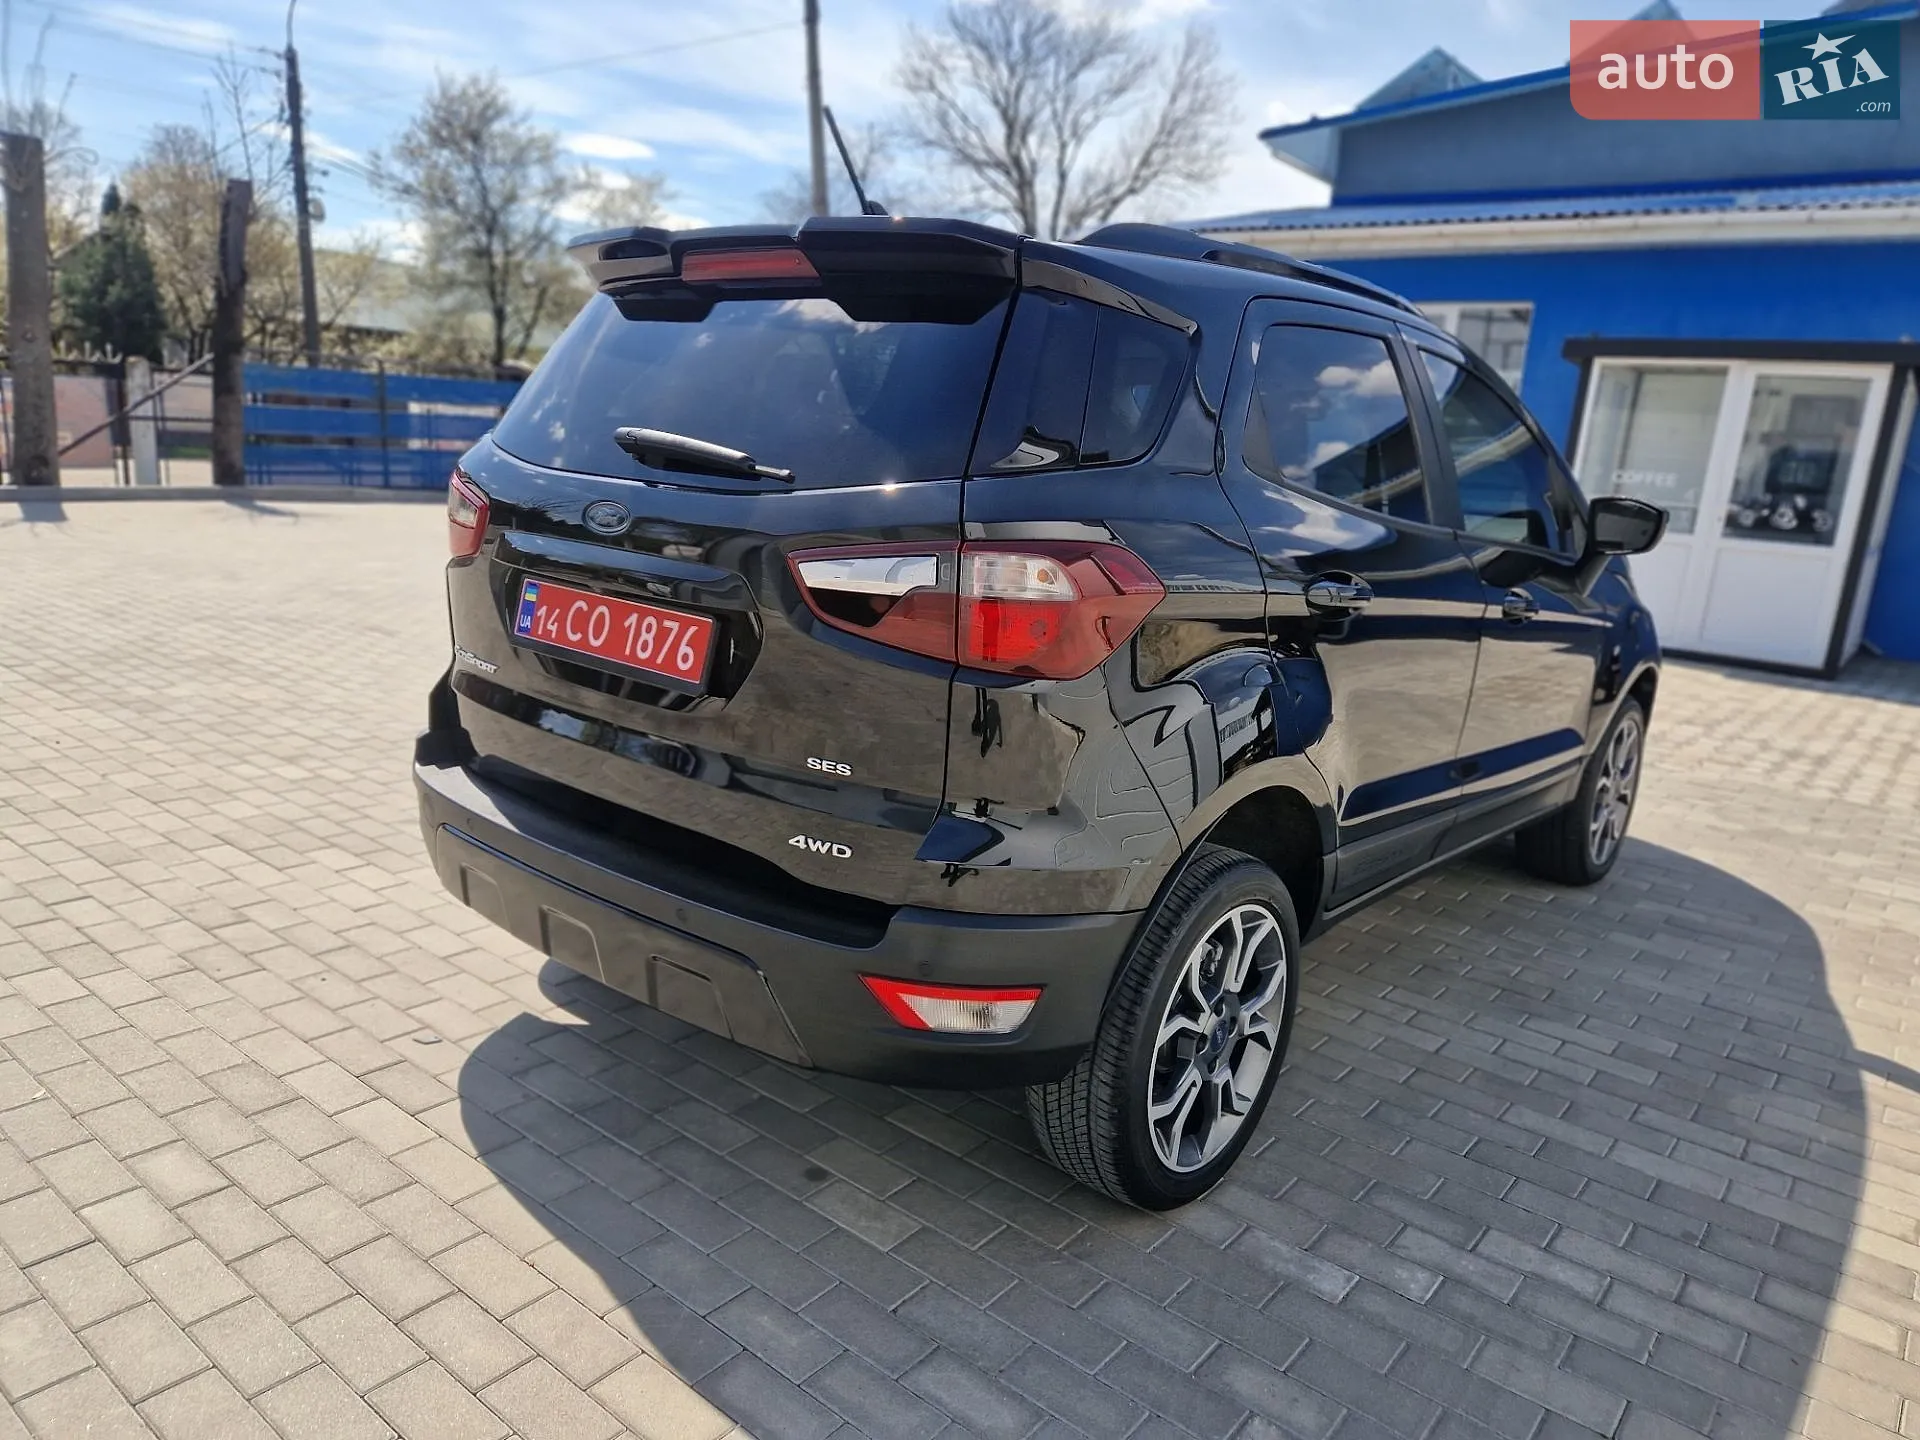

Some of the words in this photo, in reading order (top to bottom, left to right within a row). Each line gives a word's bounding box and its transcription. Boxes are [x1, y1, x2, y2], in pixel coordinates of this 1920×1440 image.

[1612, 469, 1678, 488] COFFEE
[519, 615, 531, 629] UA
[623, 612, 699, 671] 1876
[806, 757, 852, 776] SES
[788, 834, 853, 858] 4WD
